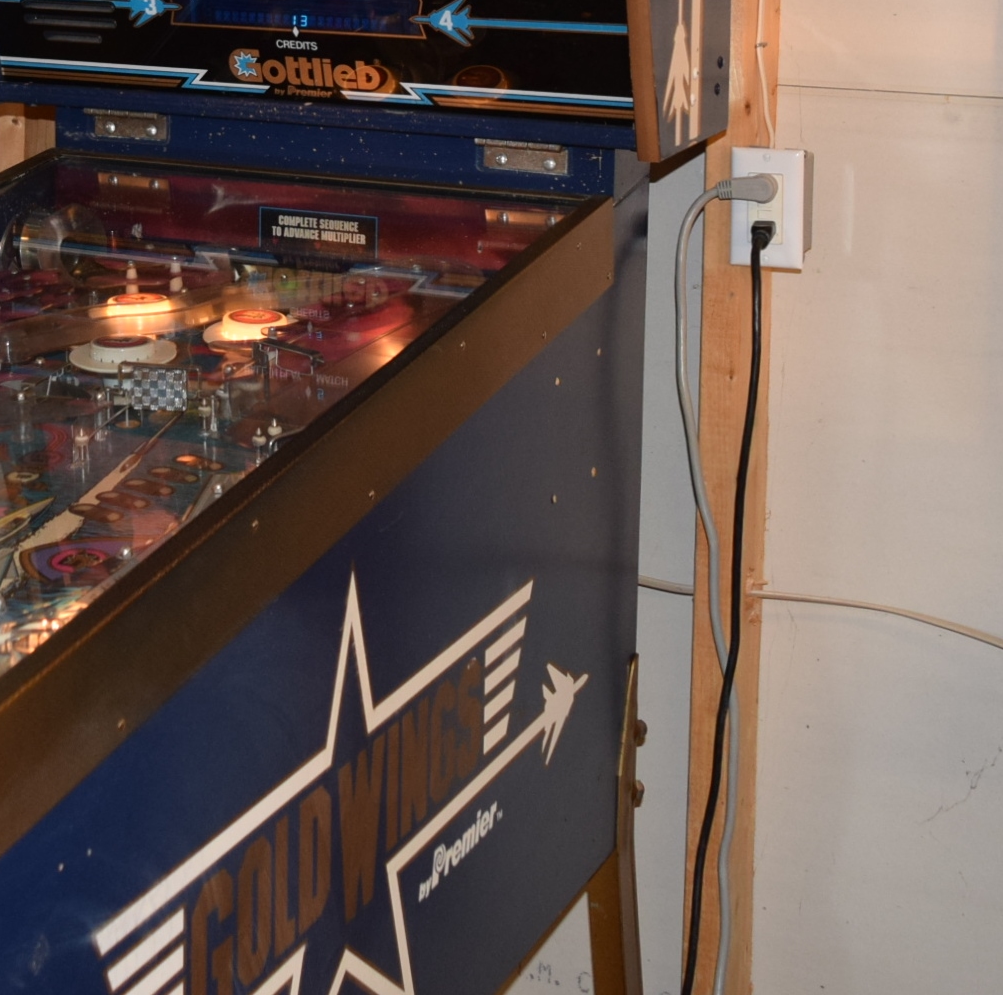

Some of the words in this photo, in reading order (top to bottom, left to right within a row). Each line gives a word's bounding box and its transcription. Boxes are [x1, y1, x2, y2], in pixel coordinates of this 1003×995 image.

[439, 10, 453, 31] 4
[275, 39, 318, 51] CREDITS
[229, 48, 381, 91] Gottlieb
[274, 88, 285, 96] by
[287, 86, 333, 98] Premier
[278, 215, 318, 229] COMPLETE
[319, 219, 359, 233] SEQUENCE
[272, 225, 282, 236] TO
[283, 227, 319, 240] ADVANCE
[321, 232, 366, 245] MULTIPLIER
[191, 785, 333, 995] GOLD
[338, 657, 482, 925] WINGS
[418, 876, 432, 903] by
[431, 801, 497, 890] Premier
